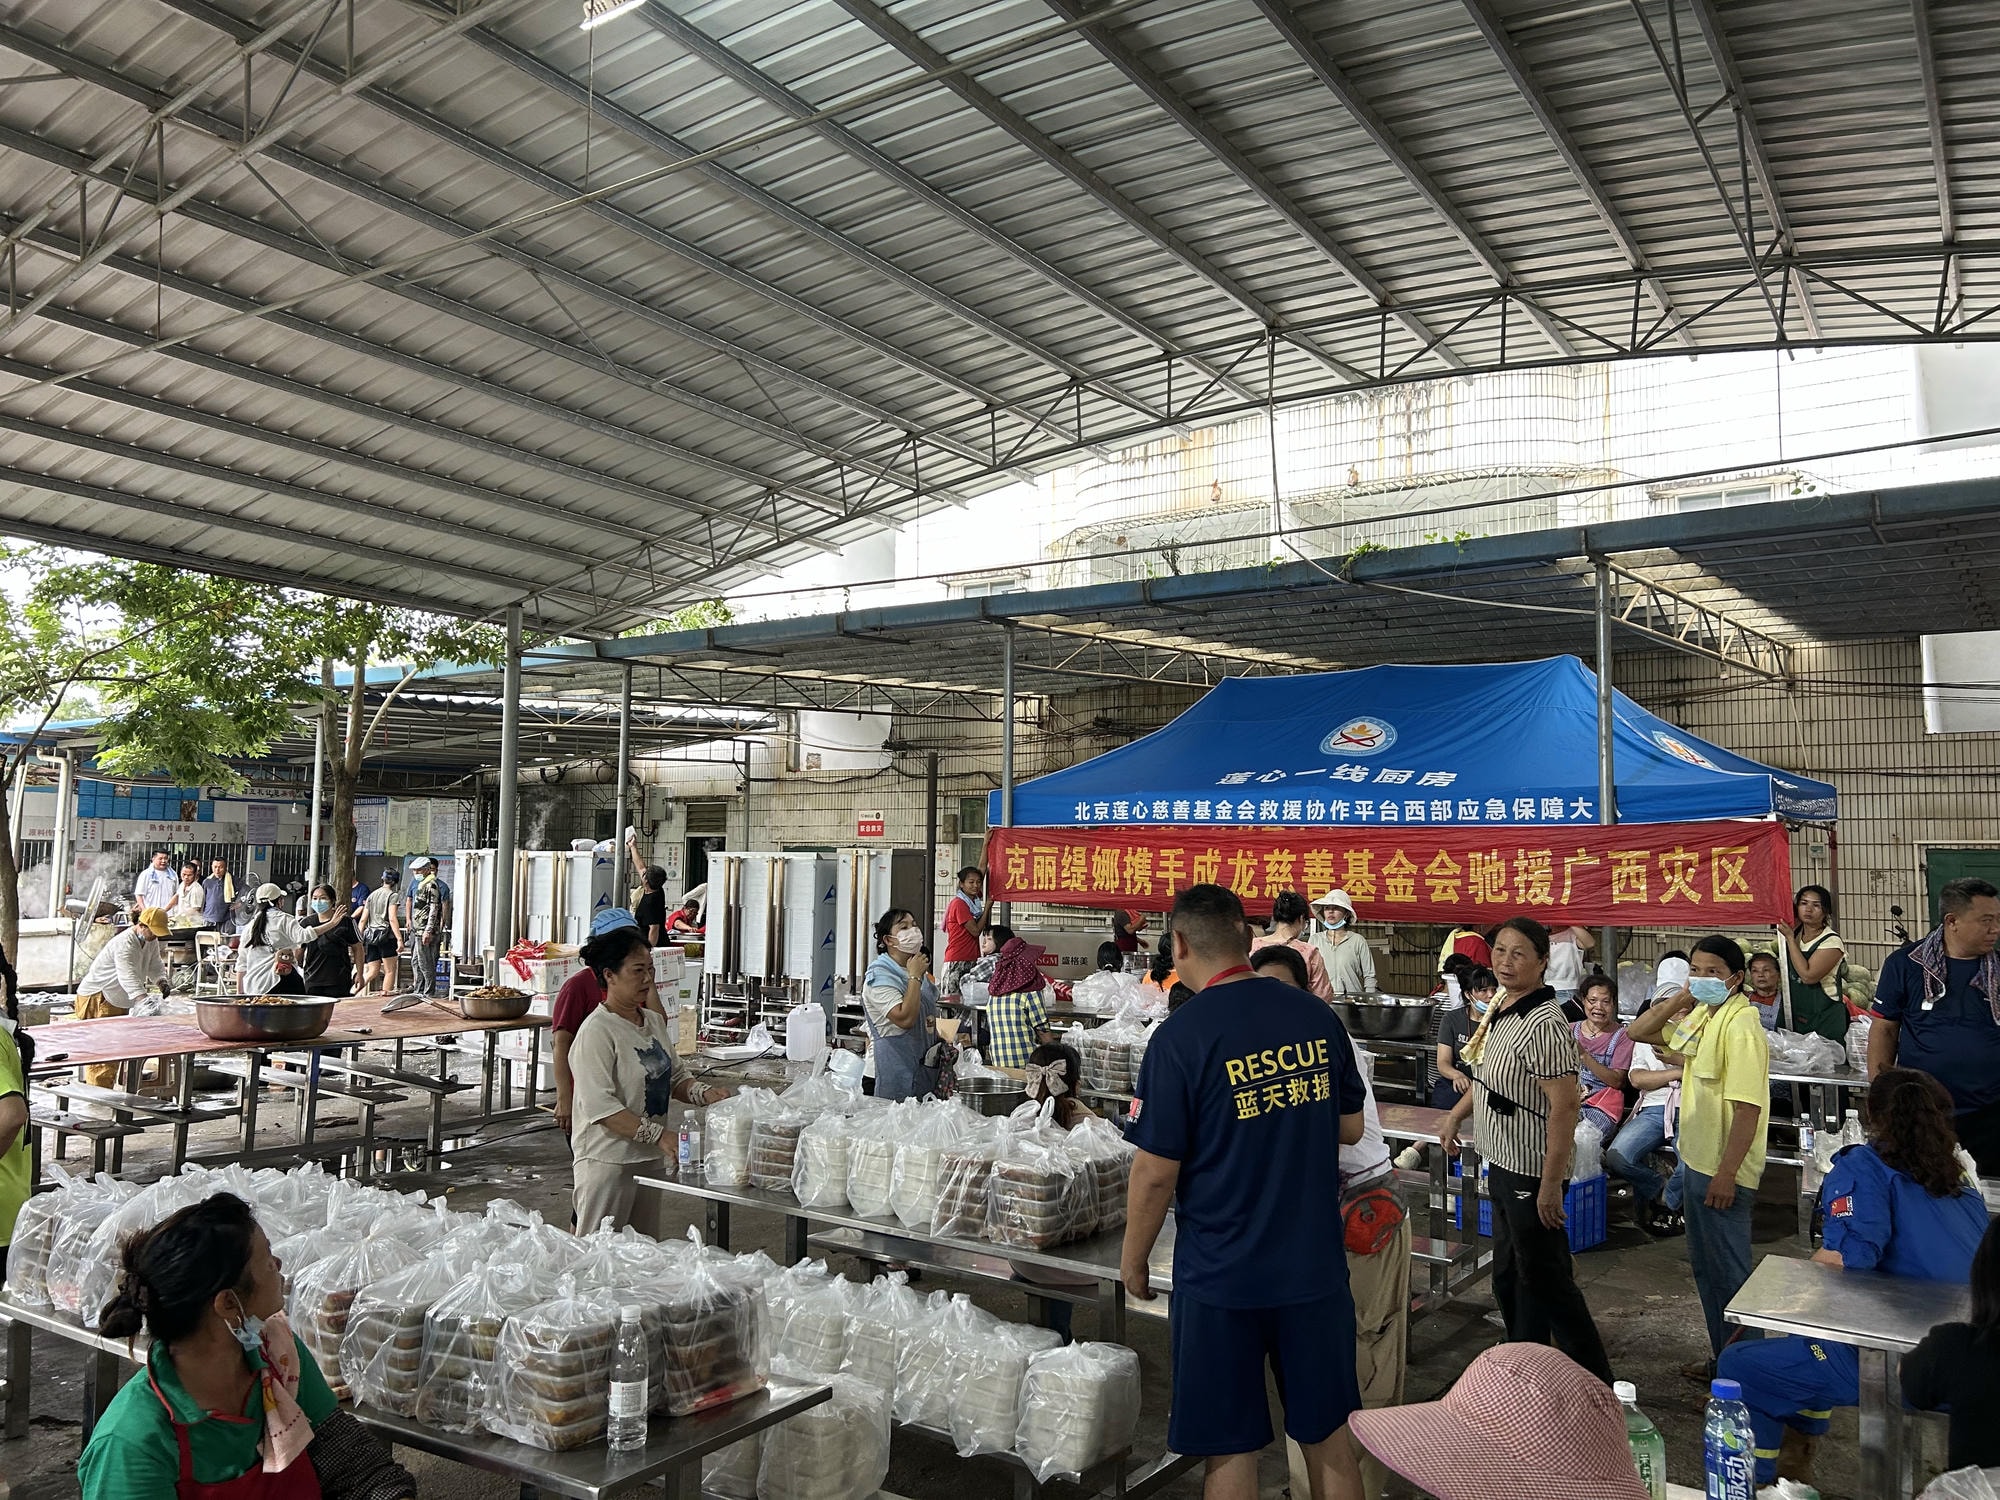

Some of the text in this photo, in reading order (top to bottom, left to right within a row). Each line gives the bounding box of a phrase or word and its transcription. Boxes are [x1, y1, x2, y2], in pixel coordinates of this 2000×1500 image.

[1216, 763, 1457, 788] 莲心一线厨房
[1075, 796, 1622, 822] 北京莲心慈善基金会救援协作平台西部应急保障大
[116, 831, 122, 840] 6
[145, 832, 150, 840] 5
[189, 833, 195, 841] 3
[211, 833, 217, 841] 2
[1005, 843, 1754, 904] 克丽缇娜携手成龙慈善基金会驰援广西灾区
[1225, 1039, 1329, 1086] RESCUE
[1234, 1072, 1331, 1120] 蓝天救援
